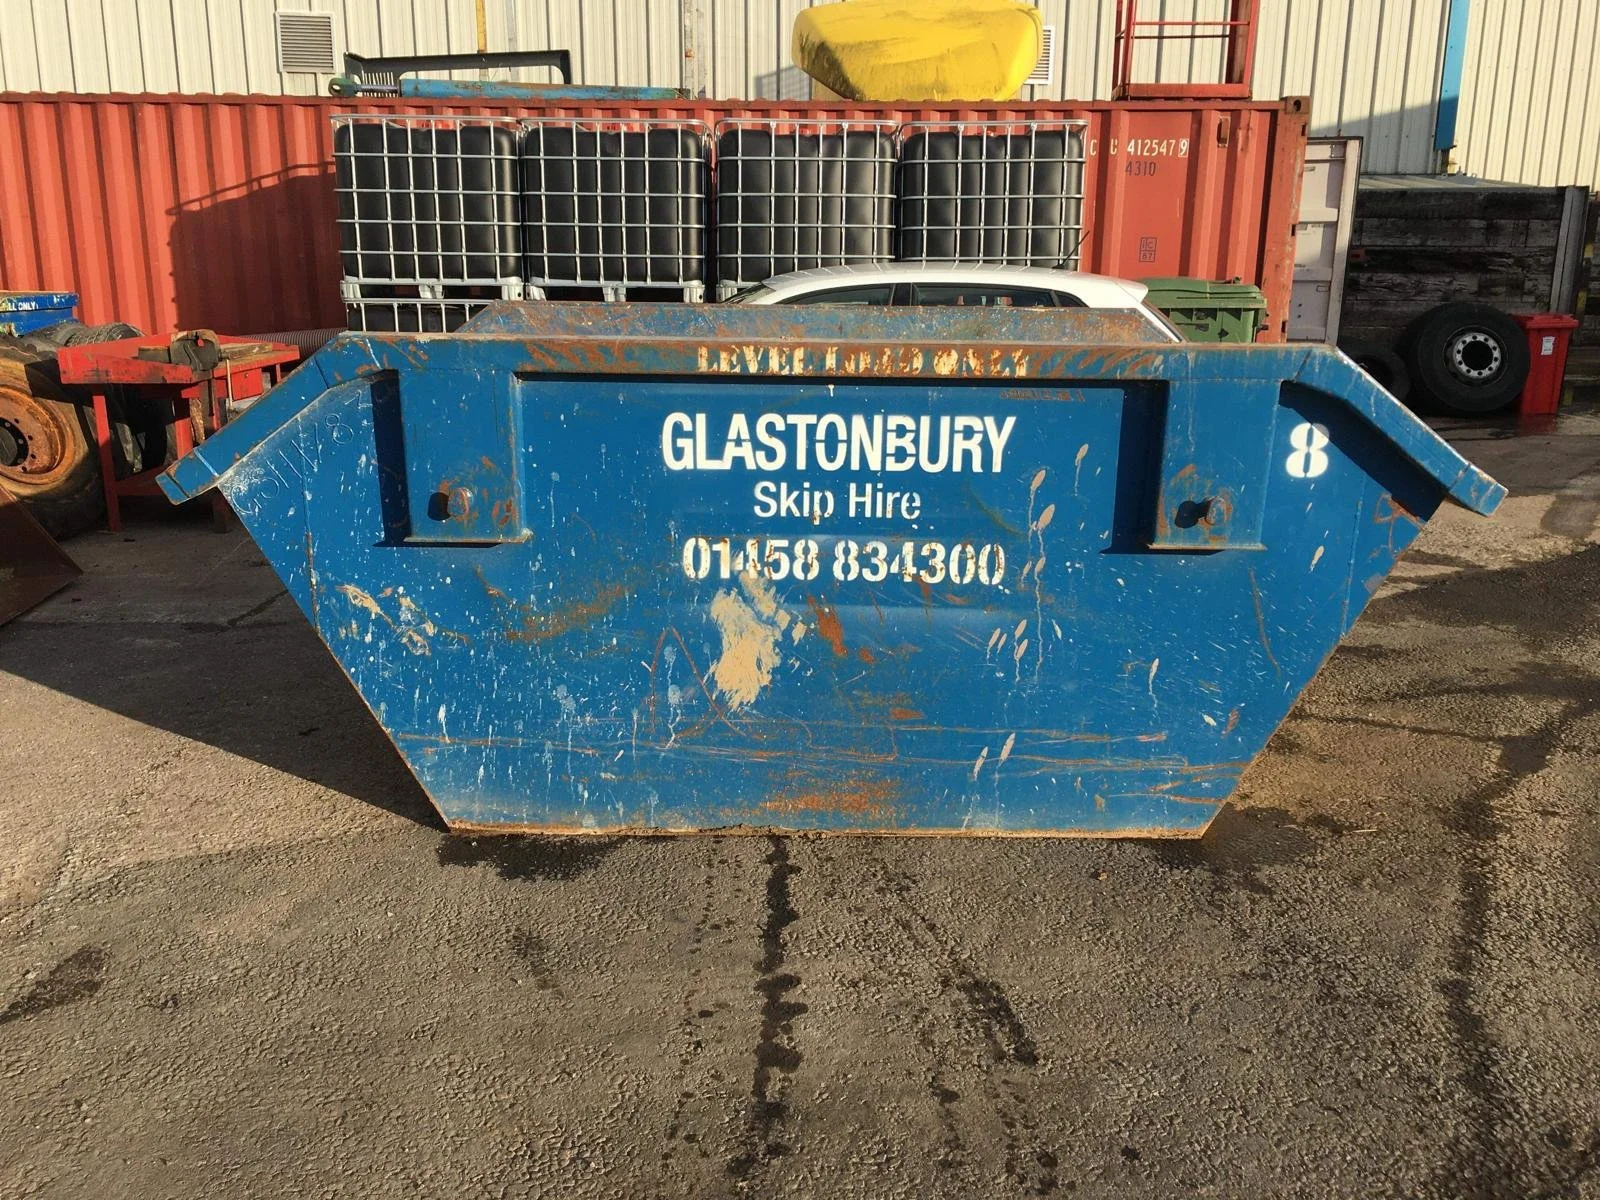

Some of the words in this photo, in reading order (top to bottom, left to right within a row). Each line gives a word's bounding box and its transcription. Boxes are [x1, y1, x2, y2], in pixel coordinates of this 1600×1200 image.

[1125, 161, 1157, 176] 4310
[18, 301, 36, 311] ONLY
[697, 345, 810, 376] LEVEL
[932, 347, 1029, 377] ONLY
[662, 413, 1017, 473] GLASTONBURY
[1286, 422, 1330, 478] 8
[754, 482, 834, 525] Skip
[849, 483, 921, 519] Hire
[682, 537, 820, 581] 01458
[832, 540, 1006, 586] 834300
